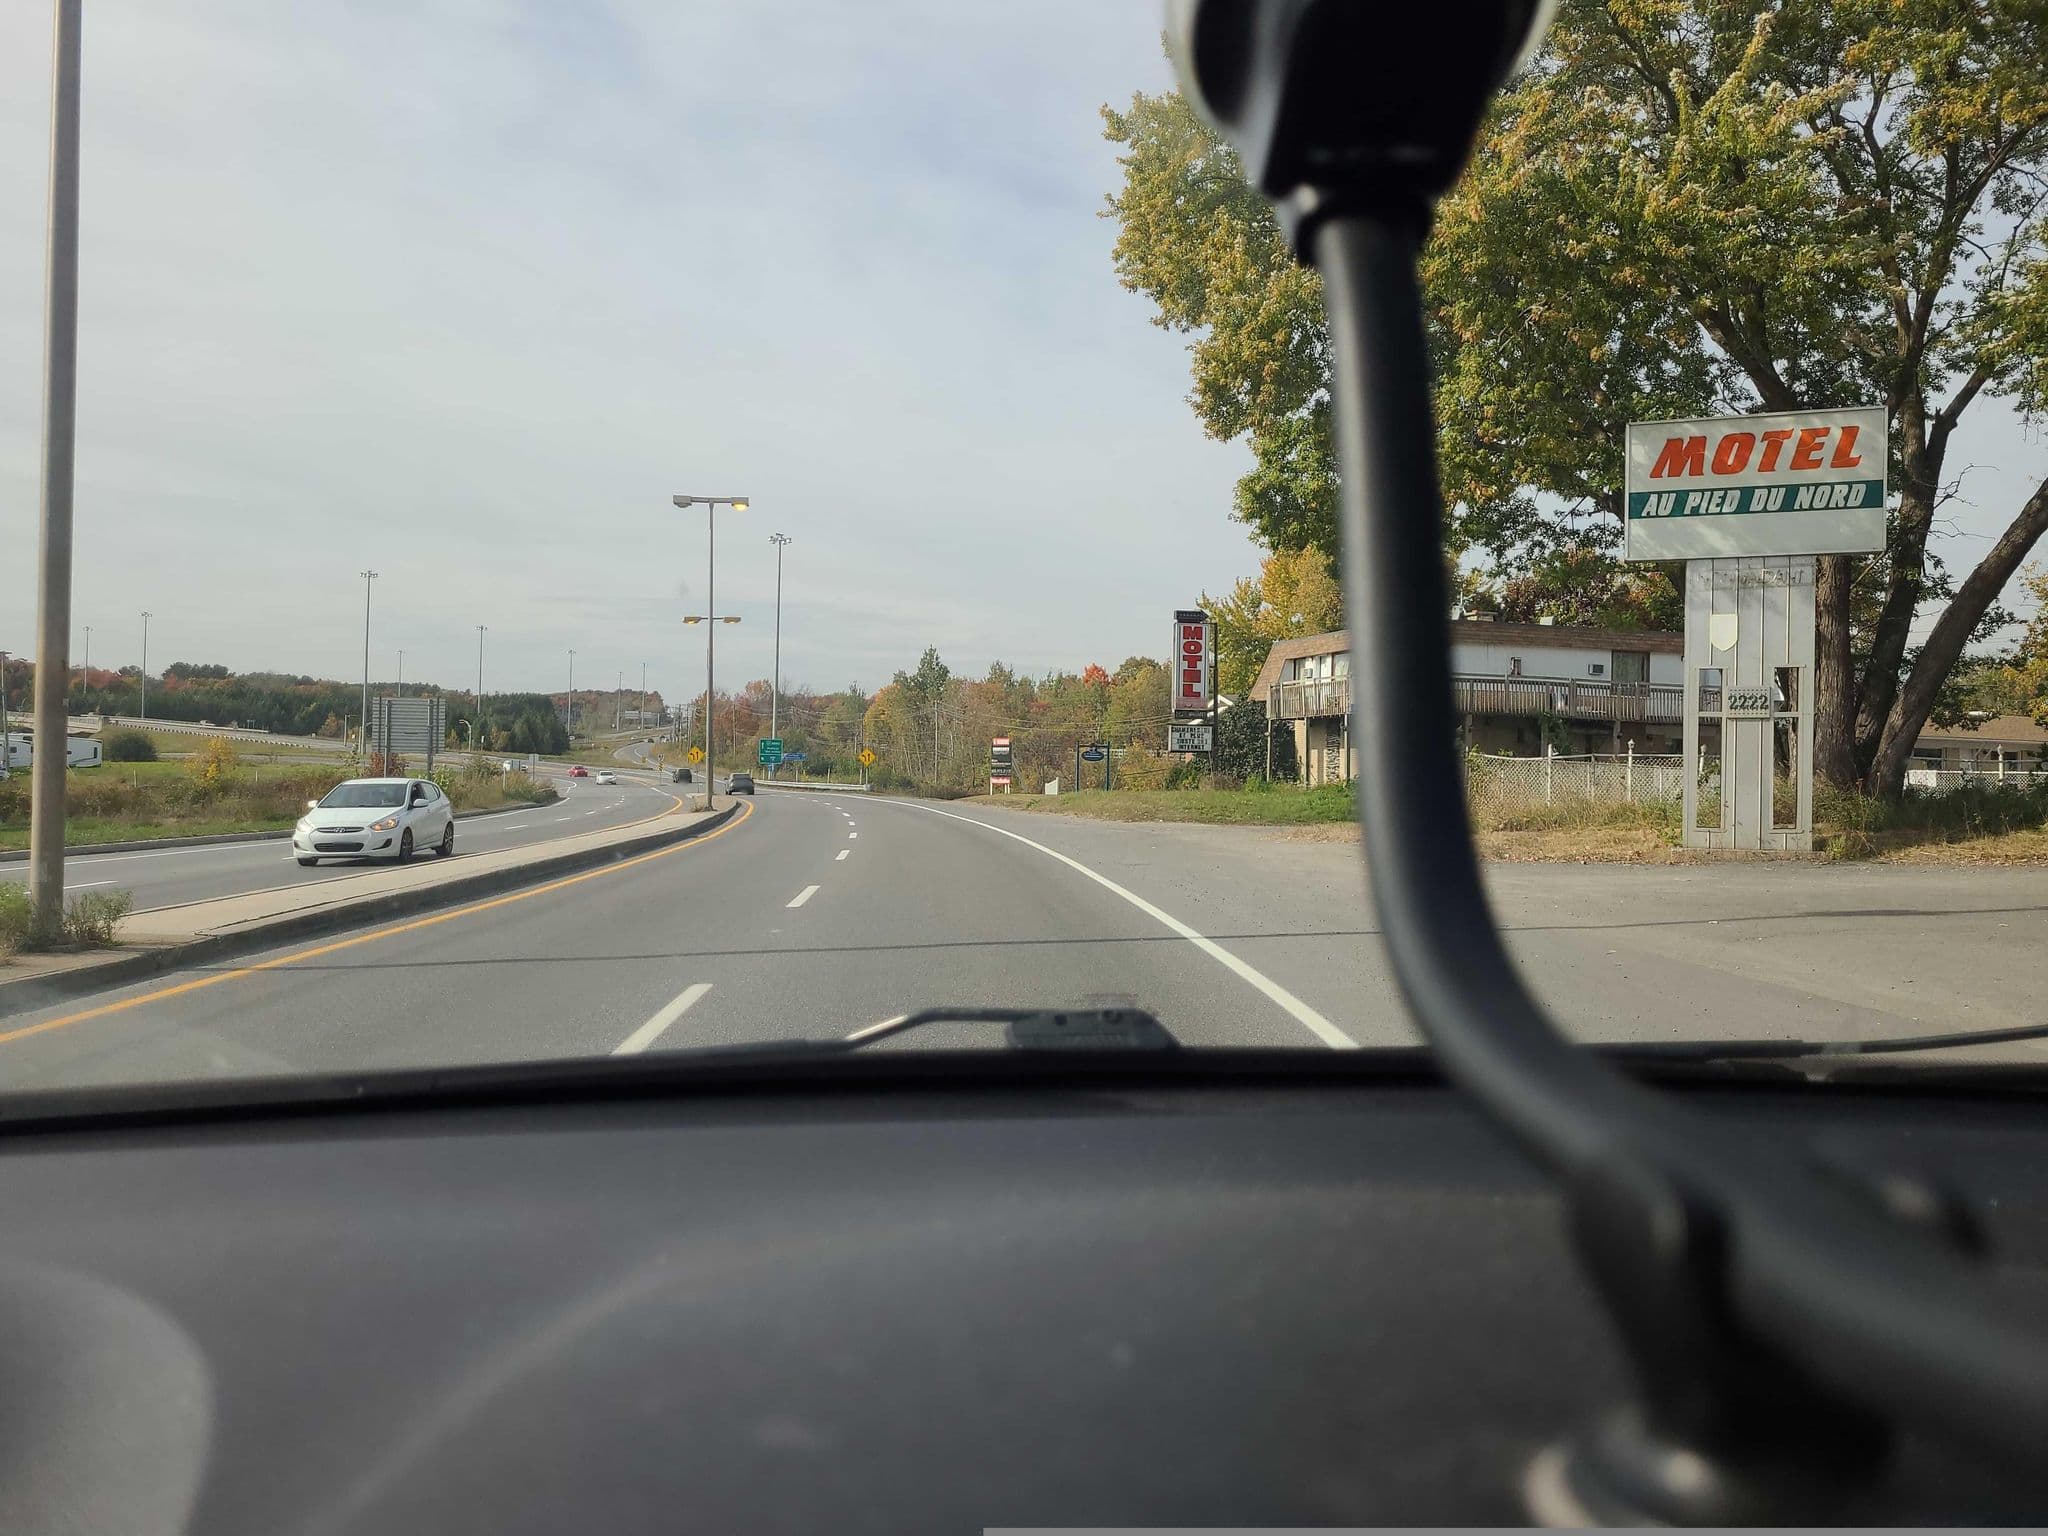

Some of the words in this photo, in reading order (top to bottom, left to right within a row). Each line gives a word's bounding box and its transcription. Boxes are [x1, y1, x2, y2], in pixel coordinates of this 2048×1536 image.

[1649, 425, 1862, 478] MOTEL
[1641, 493, 1677, 517] AU
[1683, 490, 1742, 515] PIED
[1749, 487, 1785, 511] DU
[1794, 483, 1867, 509] NORD
[1728, 694, 1769, 710] 2222
